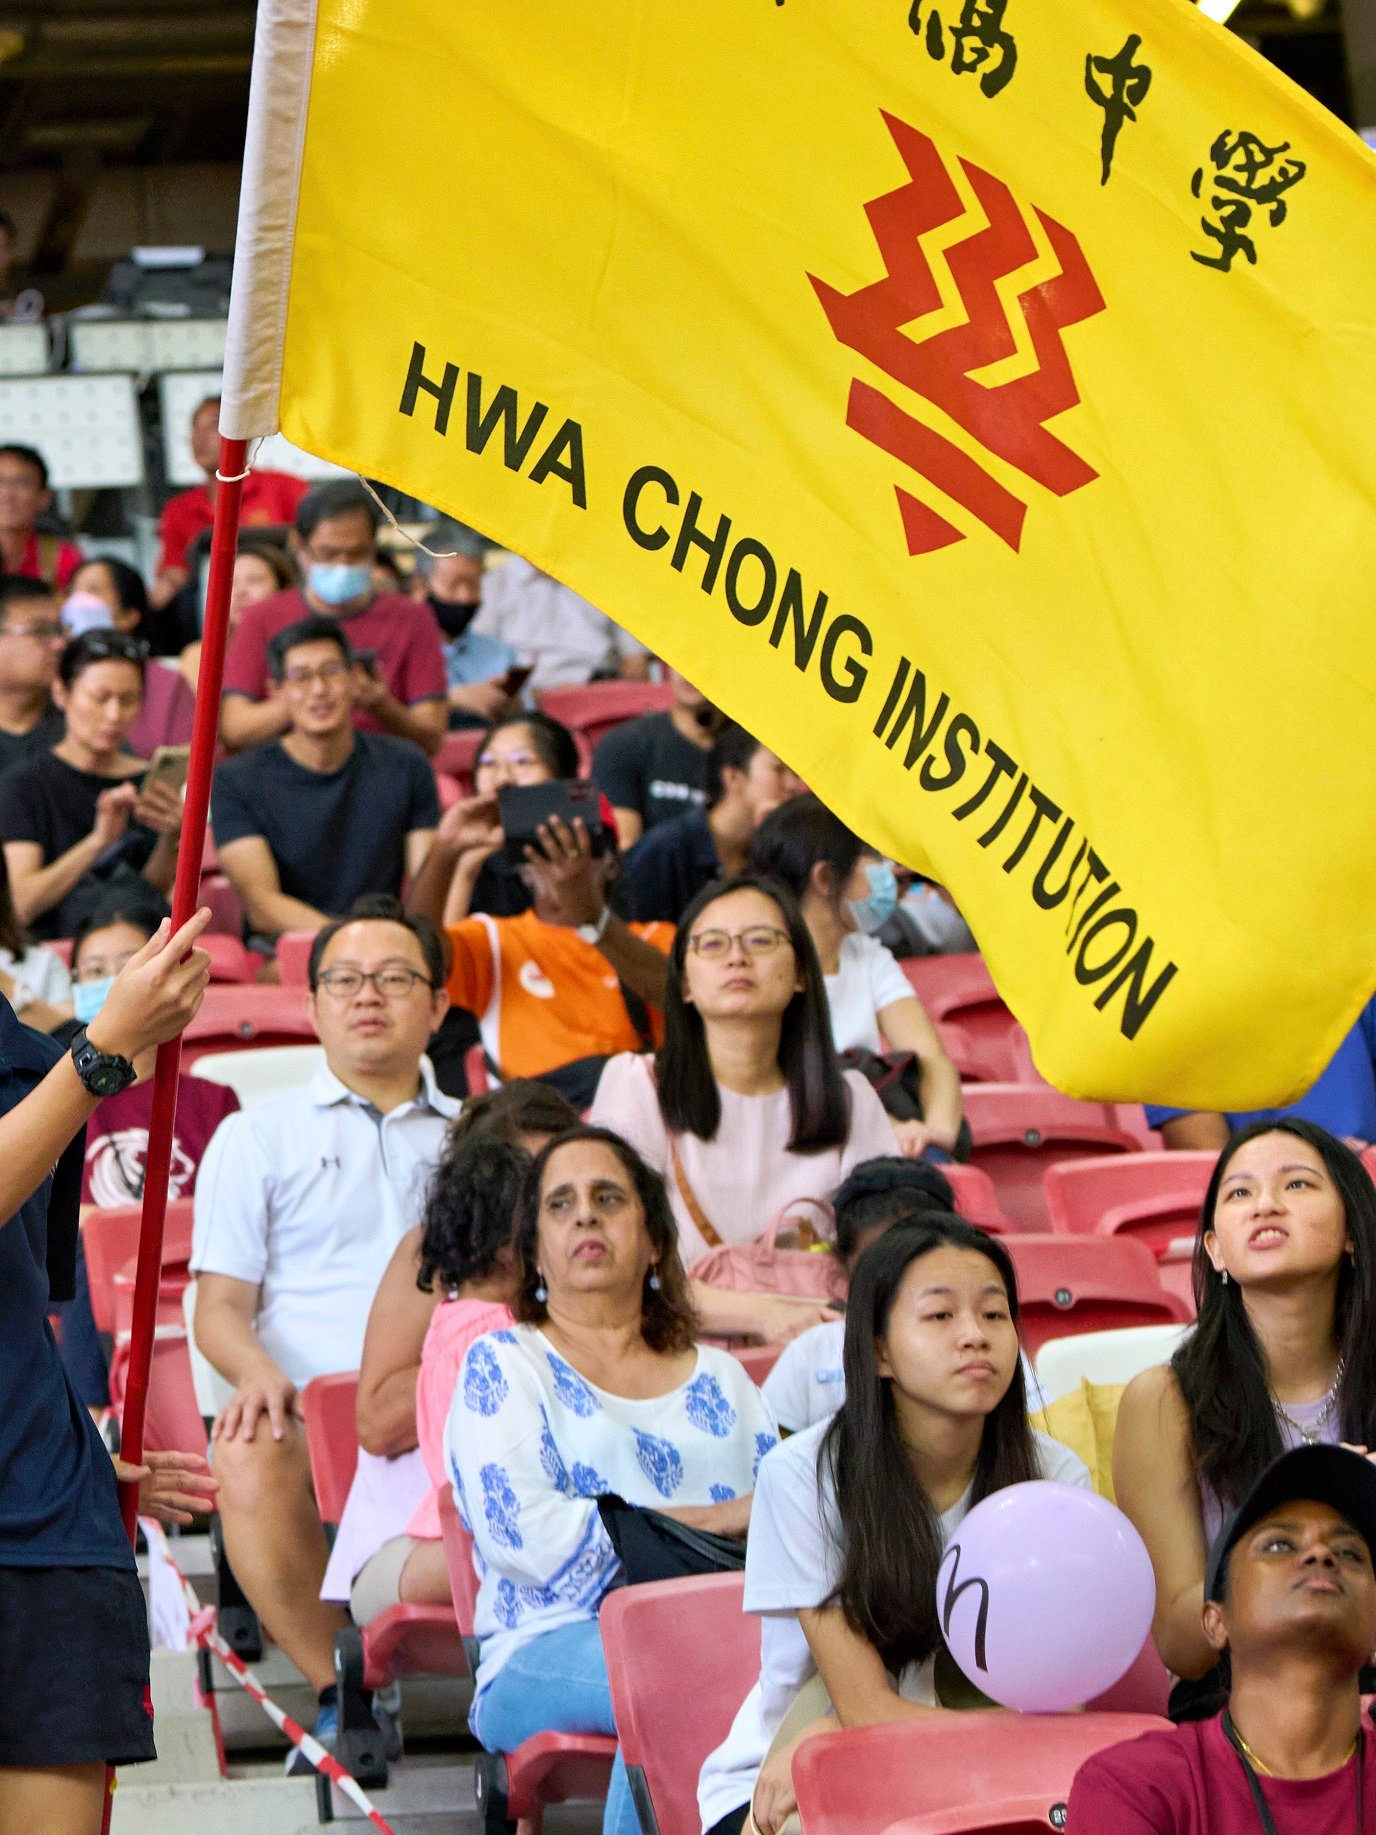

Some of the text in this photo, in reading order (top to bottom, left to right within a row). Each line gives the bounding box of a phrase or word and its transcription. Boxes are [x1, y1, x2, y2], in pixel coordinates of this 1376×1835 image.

[399, 341, 1179, 1041] HWA CHONG INSTITUTION
